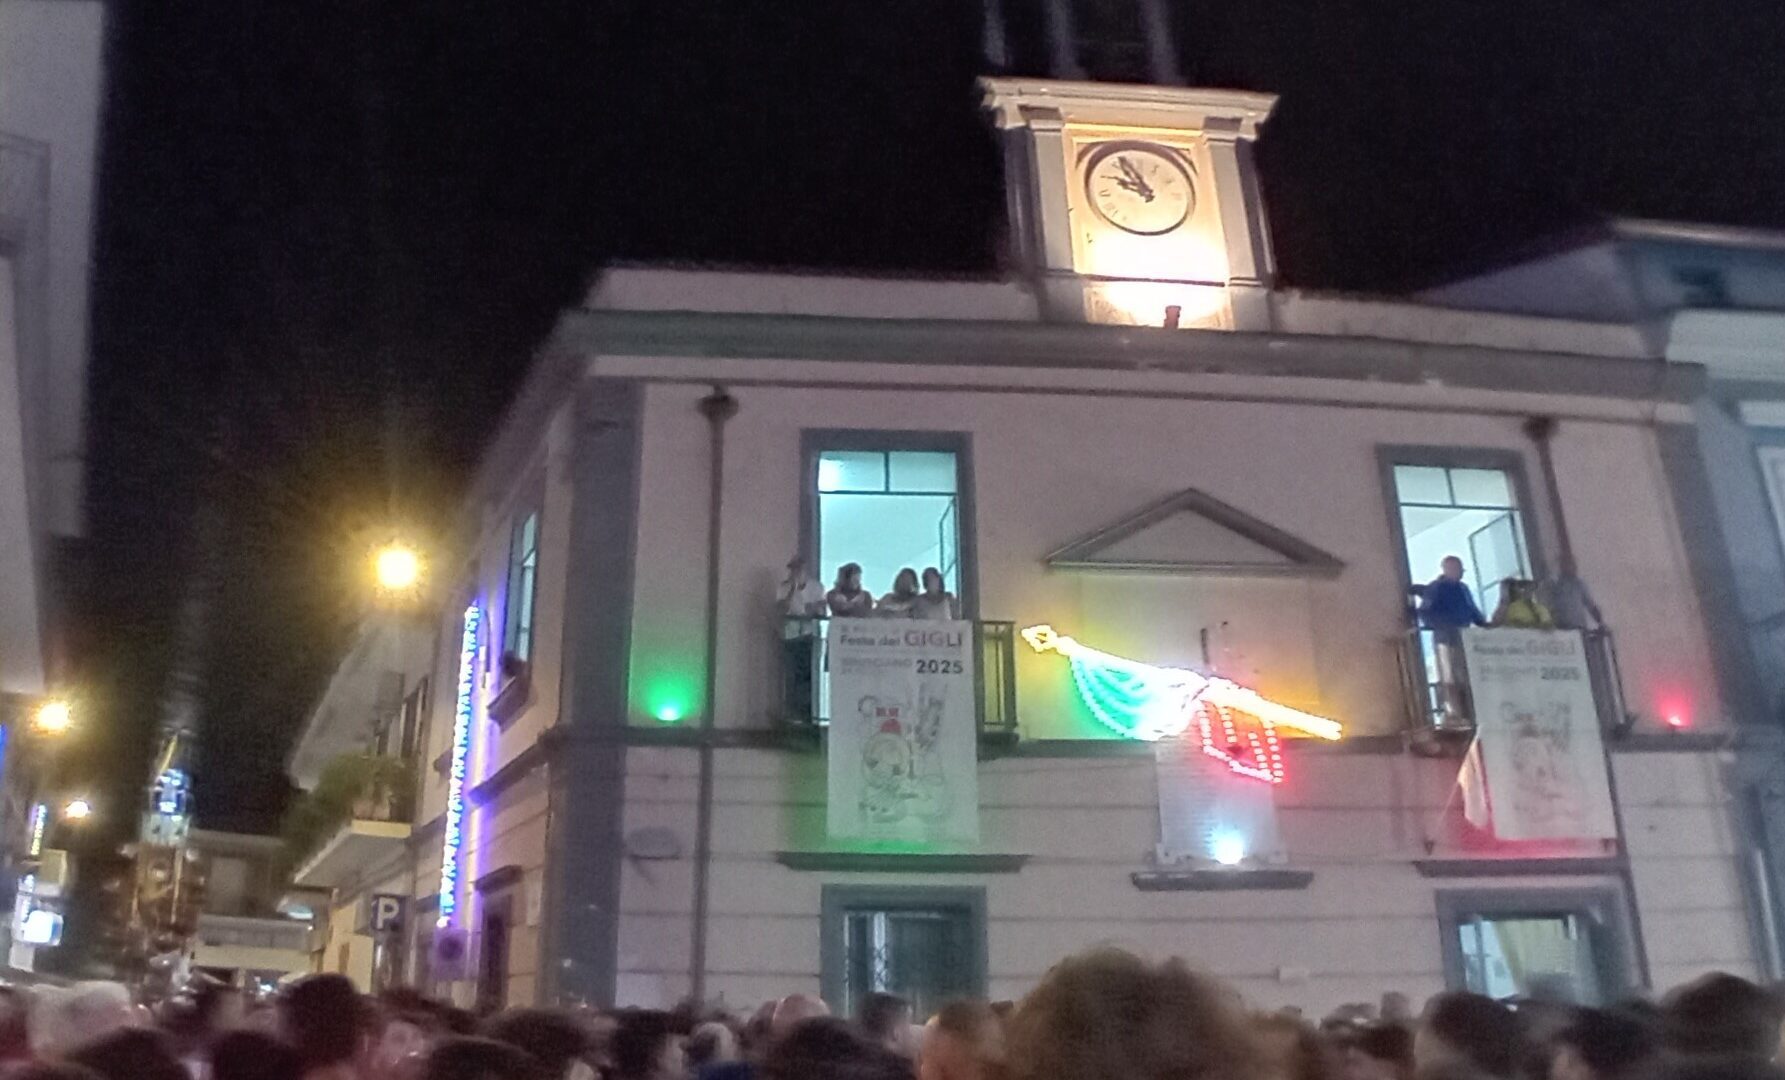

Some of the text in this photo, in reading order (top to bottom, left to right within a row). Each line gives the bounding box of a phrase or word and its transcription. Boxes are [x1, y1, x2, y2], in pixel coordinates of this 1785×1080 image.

[904, 630, 963, 647] GIGLI
[916, 659, 964, 674] 2025
[377, 896, 400, 929] P
